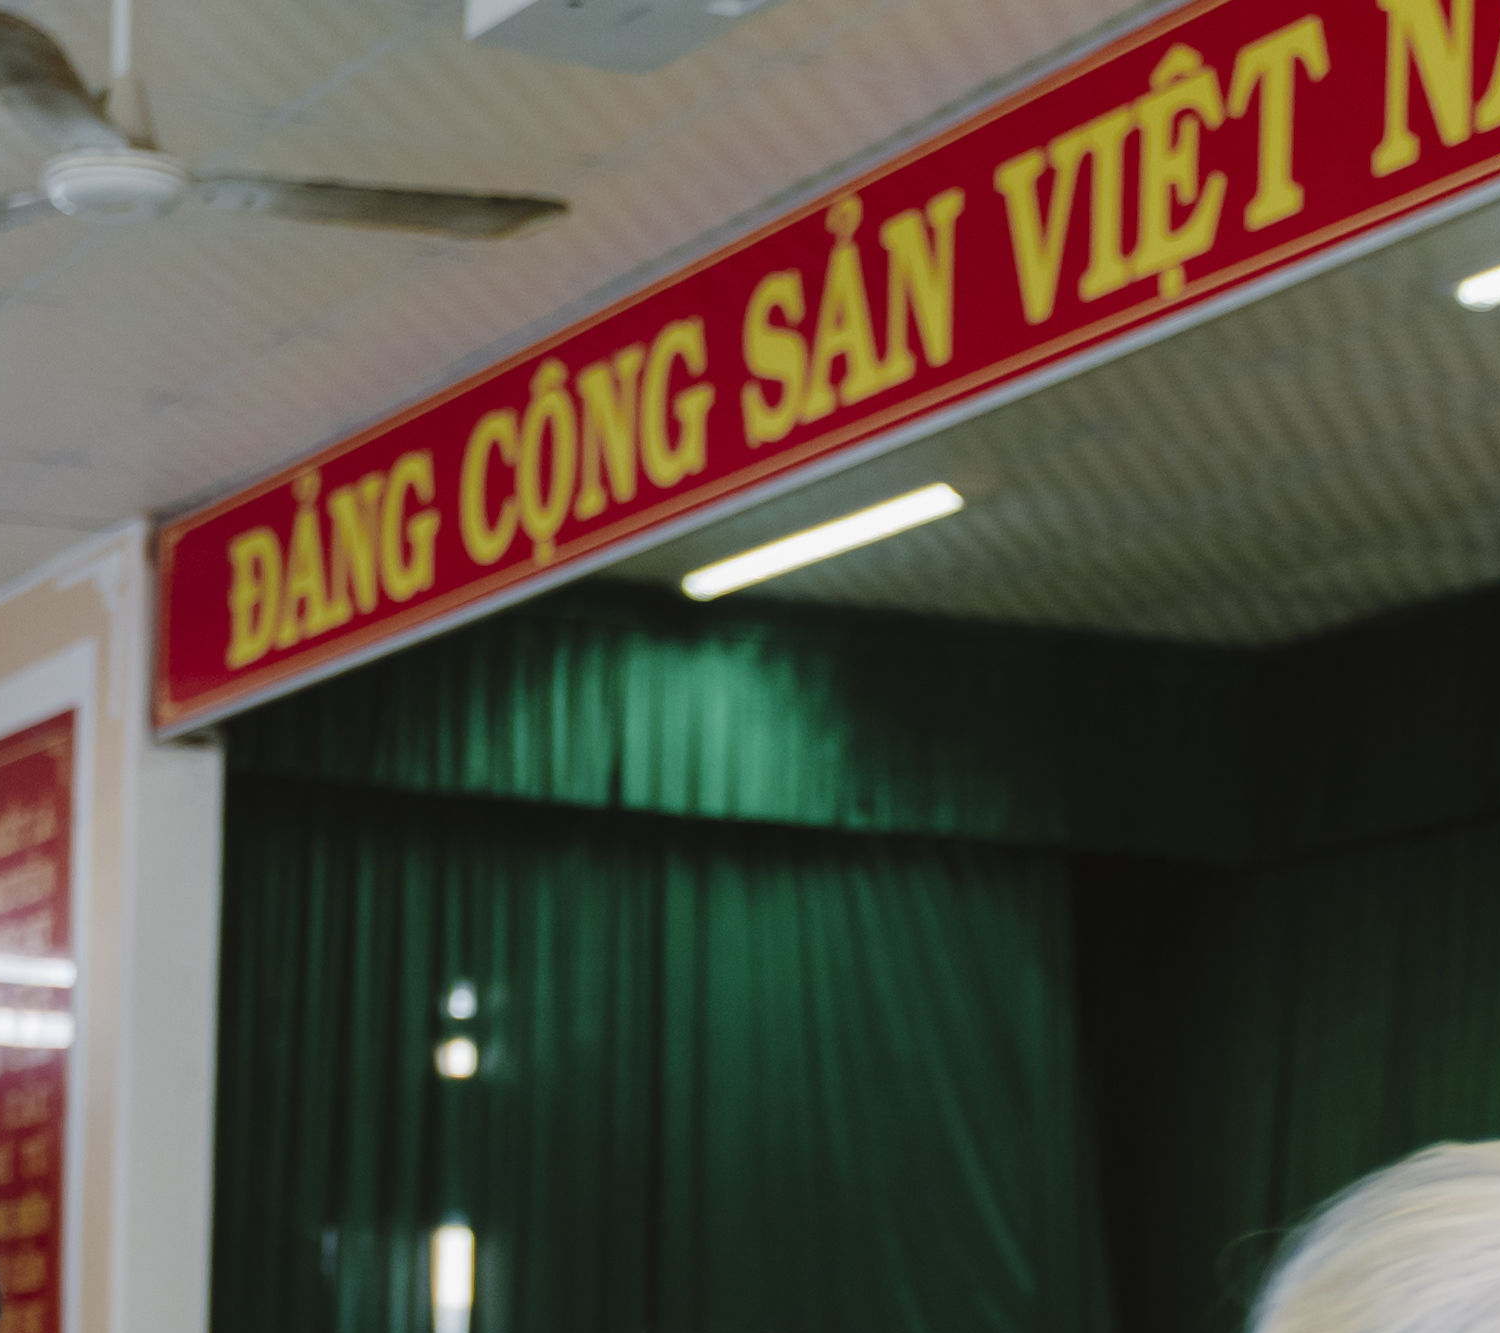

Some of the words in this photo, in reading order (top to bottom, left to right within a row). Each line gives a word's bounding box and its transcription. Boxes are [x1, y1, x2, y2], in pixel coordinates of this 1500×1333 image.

[226, 468, 441, 669] ĐẢNG
[460, 317, 715, 567] CỘNG
[741, 193, 965, 447] SẢN
[994, 14, 1330, 325] VIỆT
